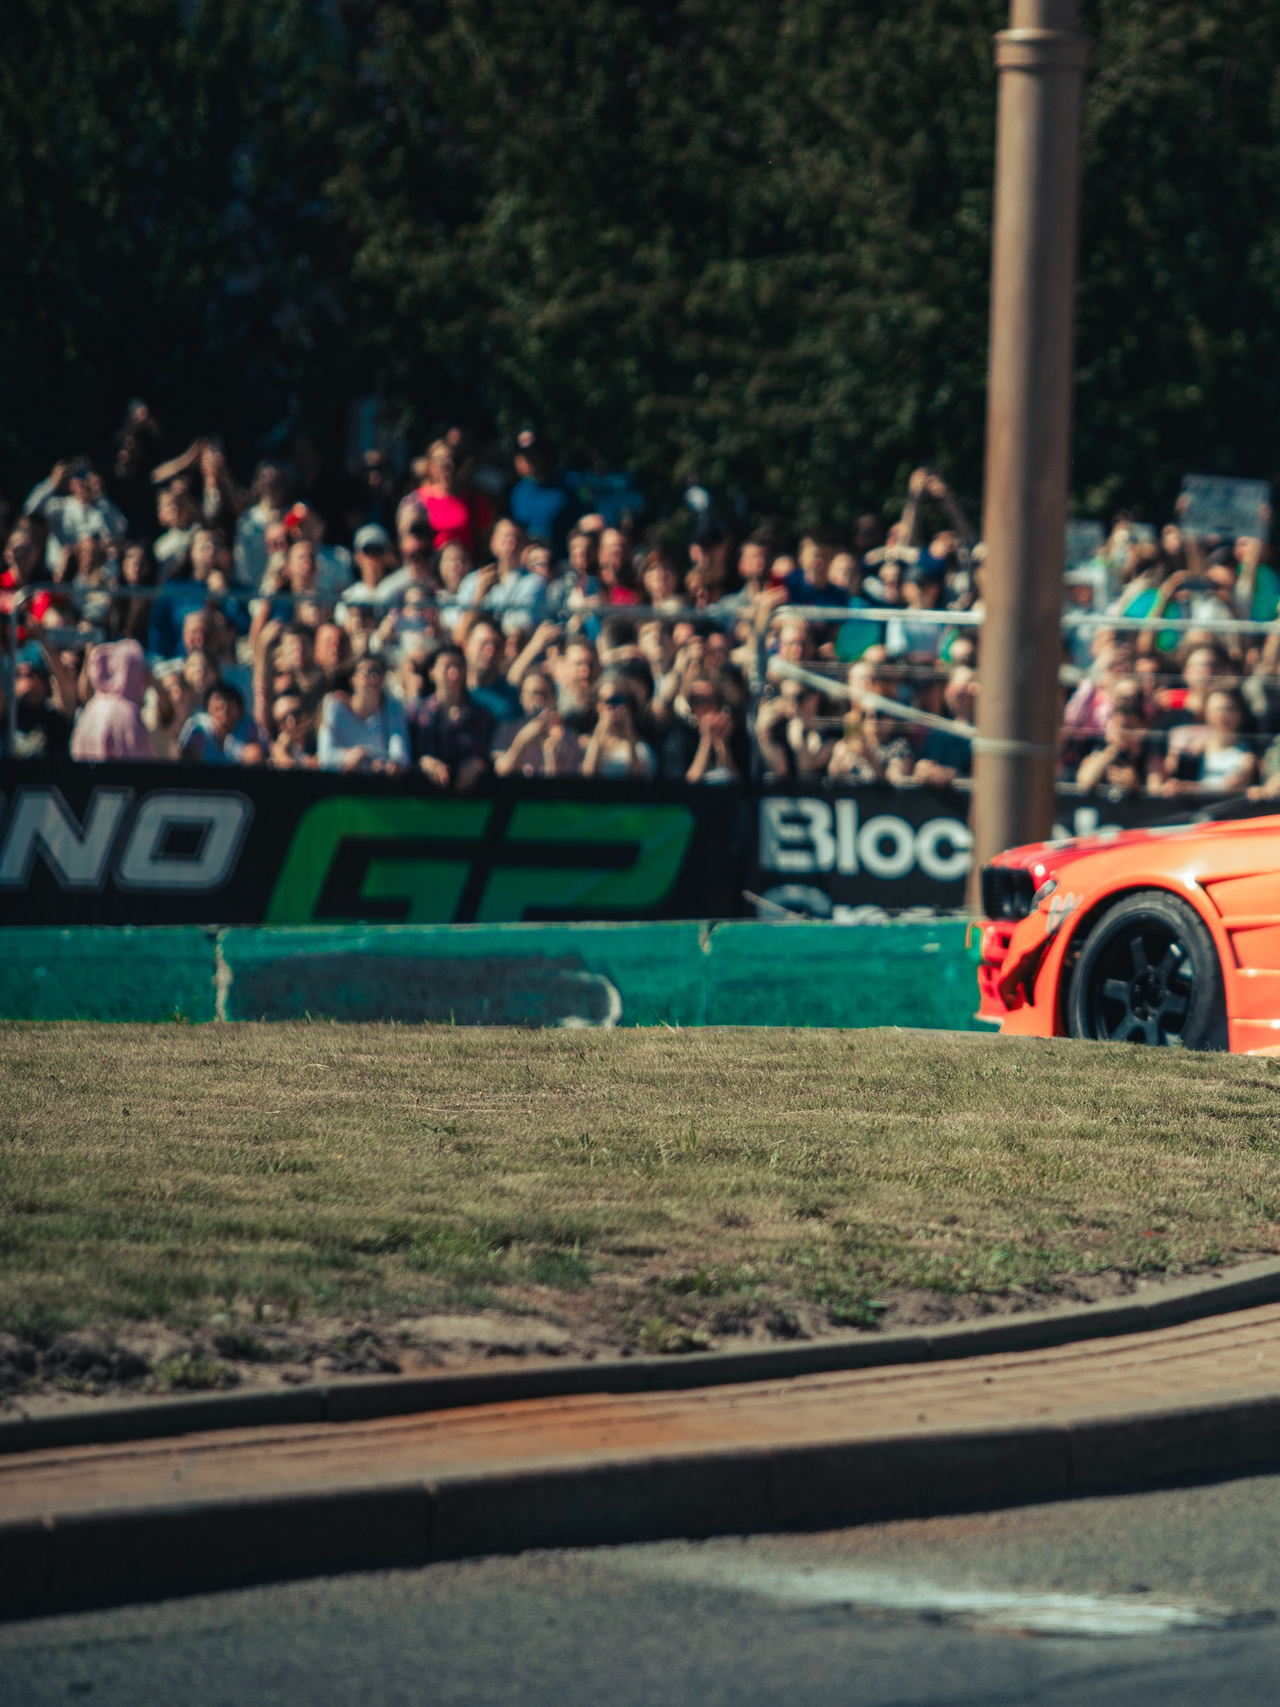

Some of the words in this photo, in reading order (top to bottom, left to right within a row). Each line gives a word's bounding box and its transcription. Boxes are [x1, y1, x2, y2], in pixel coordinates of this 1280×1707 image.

[0, 787, 252, 890] NO
[263, 795, 696, 923] GP
[760, 798, 974, 881] Bloc
